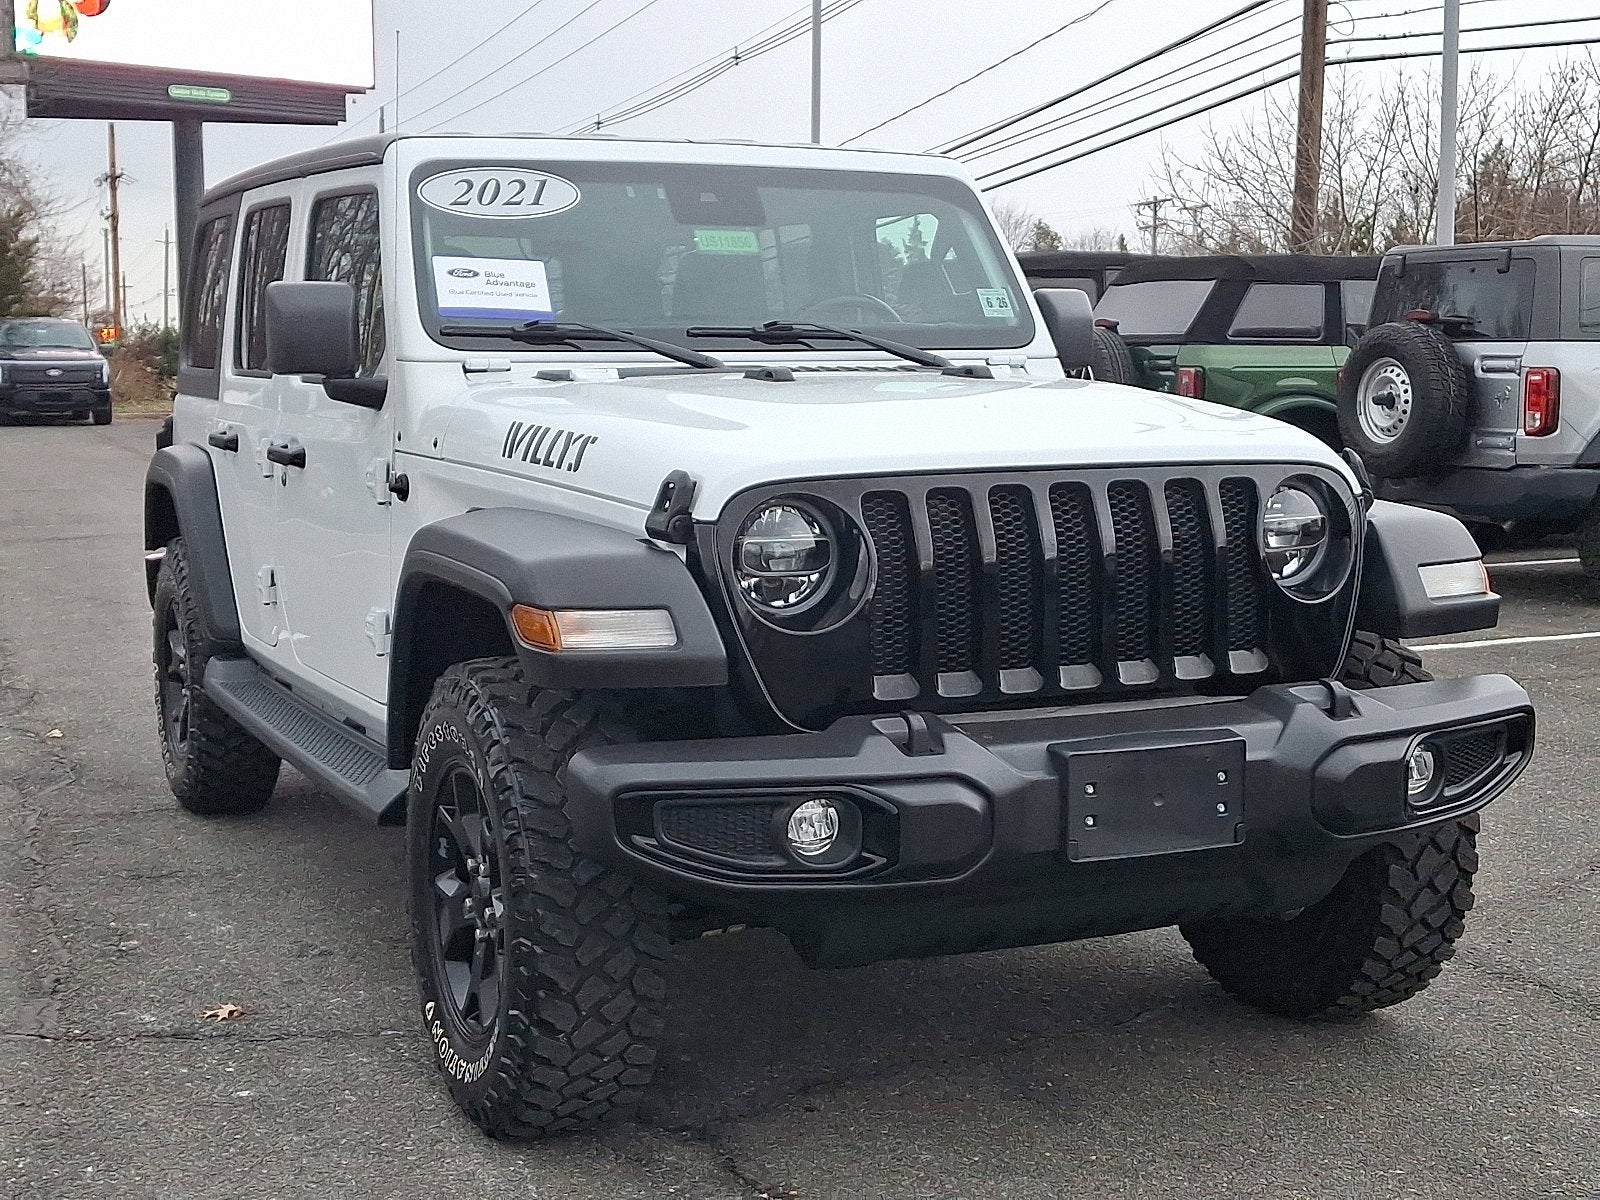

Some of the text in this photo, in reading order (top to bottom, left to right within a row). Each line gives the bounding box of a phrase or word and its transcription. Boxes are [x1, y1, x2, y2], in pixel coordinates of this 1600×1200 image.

[449, 178, 548, 206] 2021
[484, 270, 505, 278] Blue
[485, 279, 536, 288] Advantage
[986, 296, 1008, 308] 6 26
[501, 420, 599, 473] WILLYS
